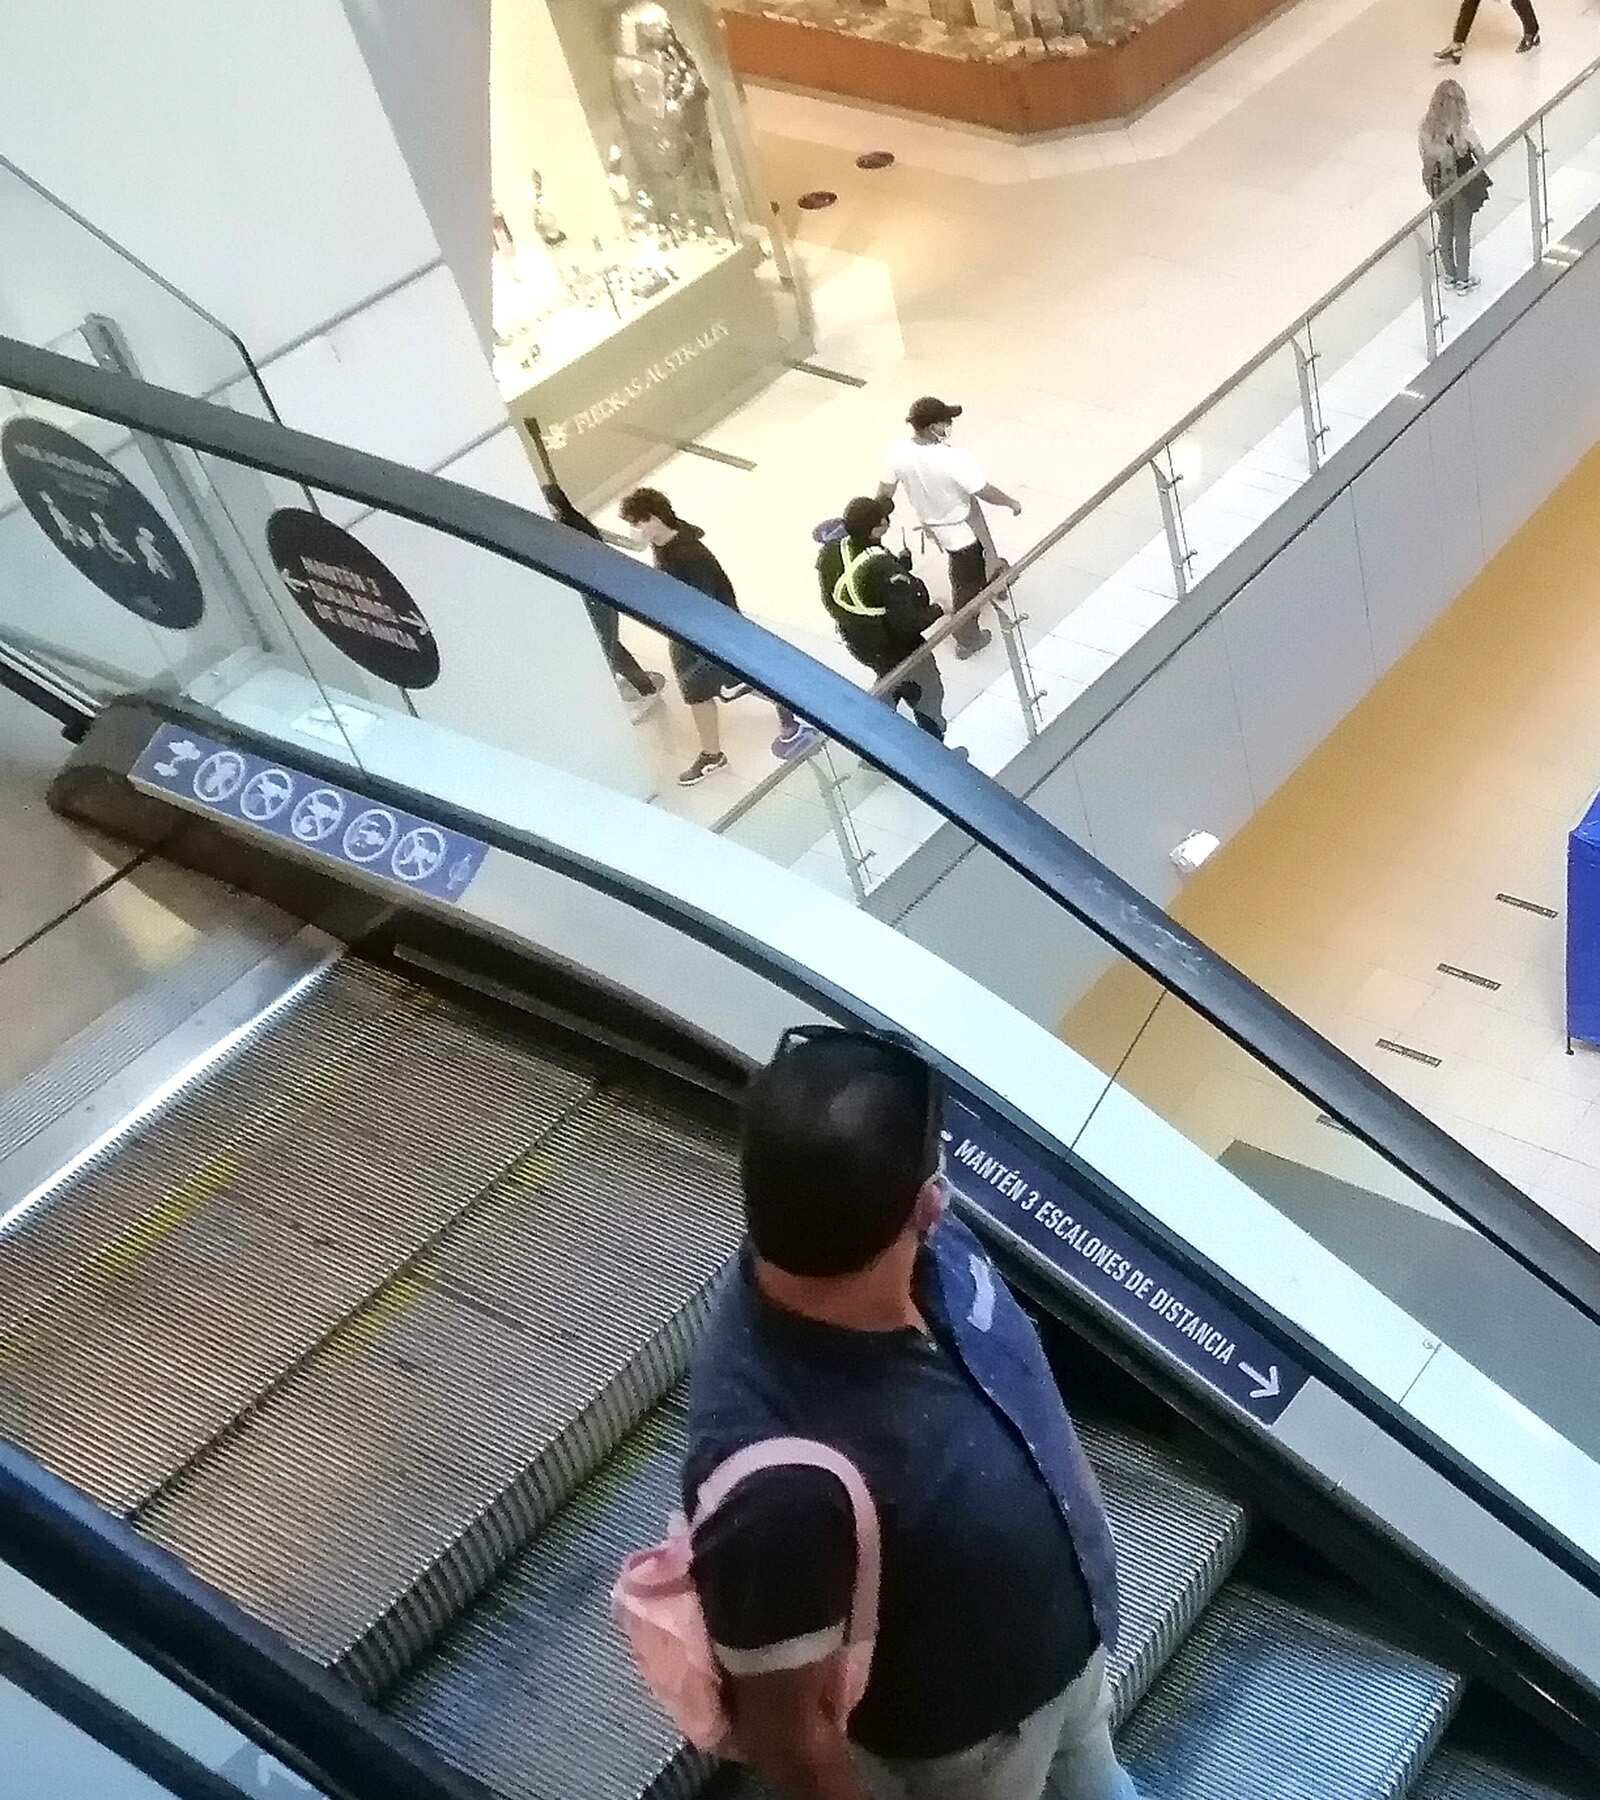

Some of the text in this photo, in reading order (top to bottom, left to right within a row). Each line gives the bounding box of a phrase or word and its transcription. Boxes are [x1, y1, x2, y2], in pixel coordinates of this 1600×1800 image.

[953, 1138, 1237, 1365] MANTÉN 3 ESCALONES DE DISTANCIA
